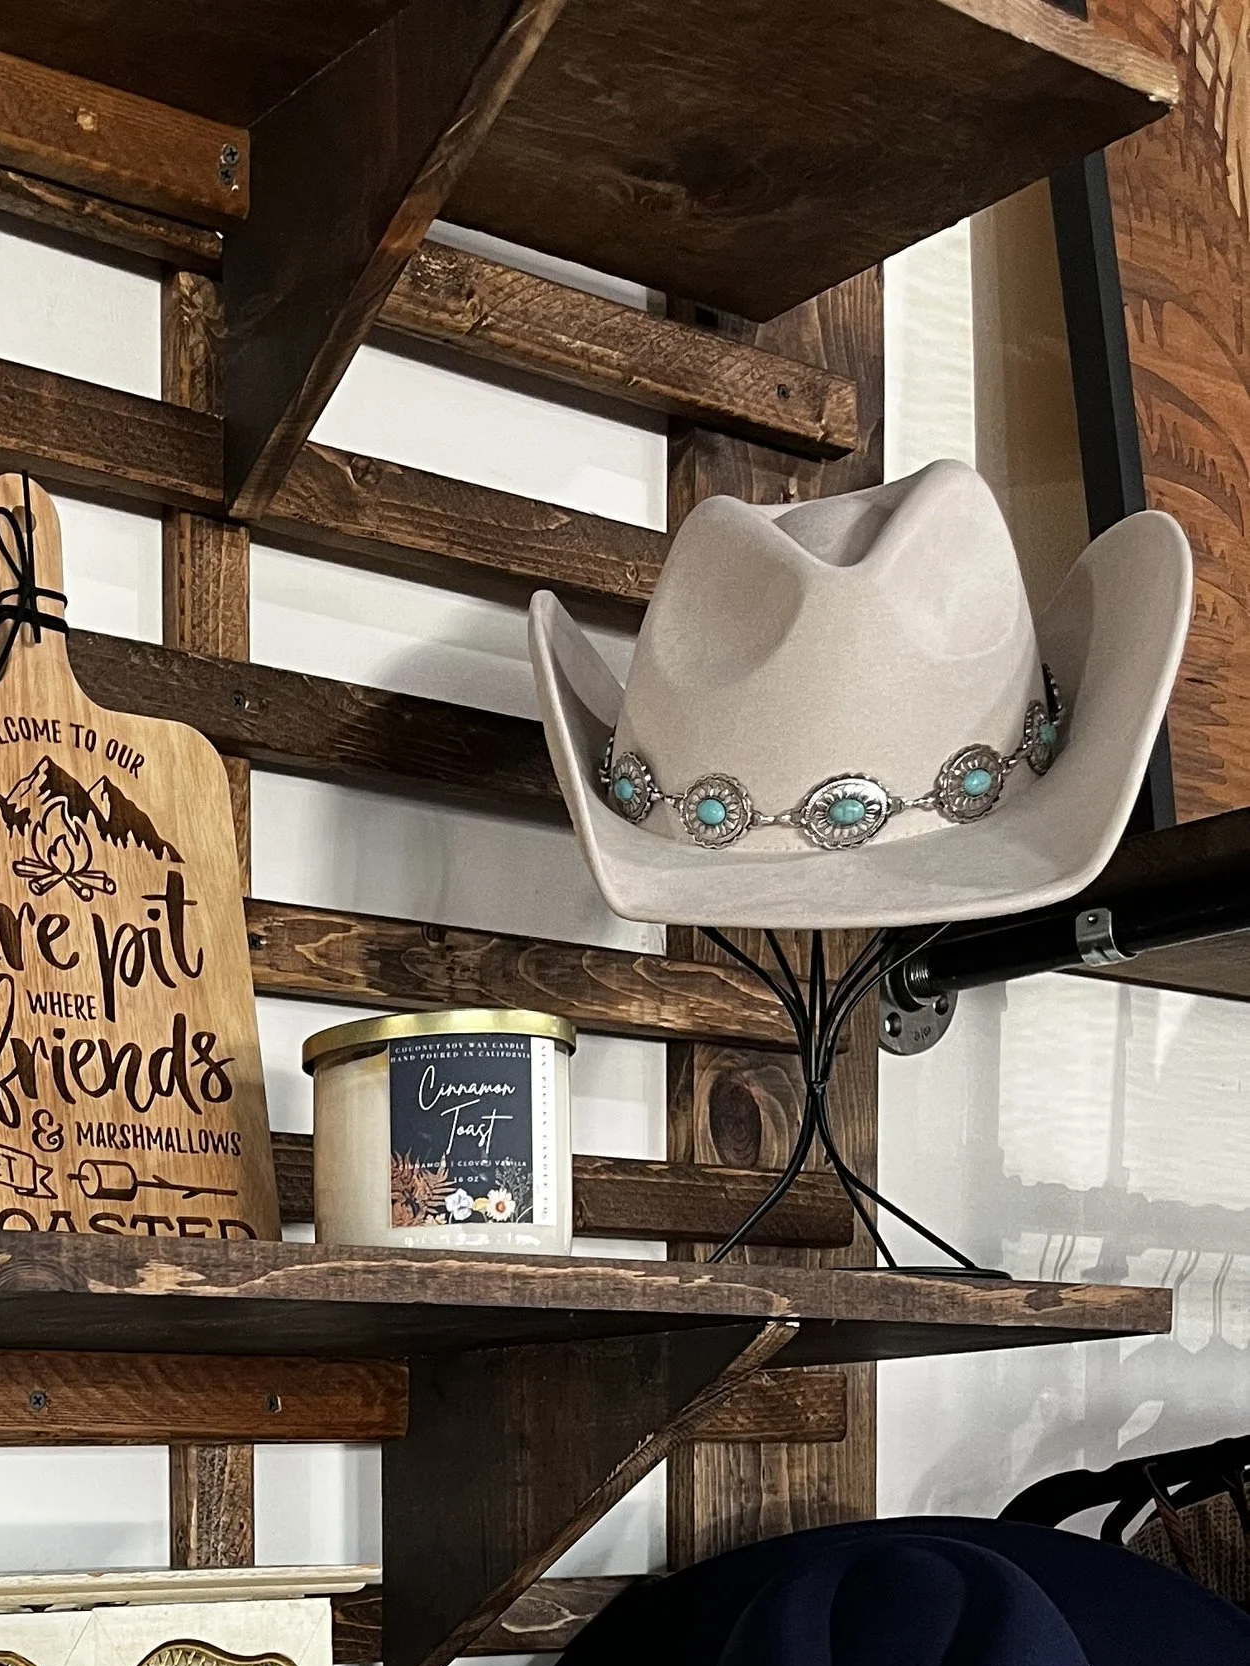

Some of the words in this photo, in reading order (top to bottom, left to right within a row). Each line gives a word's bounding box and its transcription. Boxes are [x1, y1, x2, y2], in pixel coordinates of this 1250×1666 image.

[69, 723, 97, 753] TO
[105, 737, 145, 778] OUR
[91, 870, 205, 1022] pit
[28, 990, 97, 1021] WHERE
[390, 1055, 416, 1064] HAND
[420, 1051, 459, 1060] POURED
[464, 1050, 474, 1058] IN
[419, 1065, 516, 1111] Cinnamon
[30, 1109, 65, 1152] &
[75, 1121, 242, 1157] MARSHMALLOWS
[440, 1099, 513, 1155] Toast
